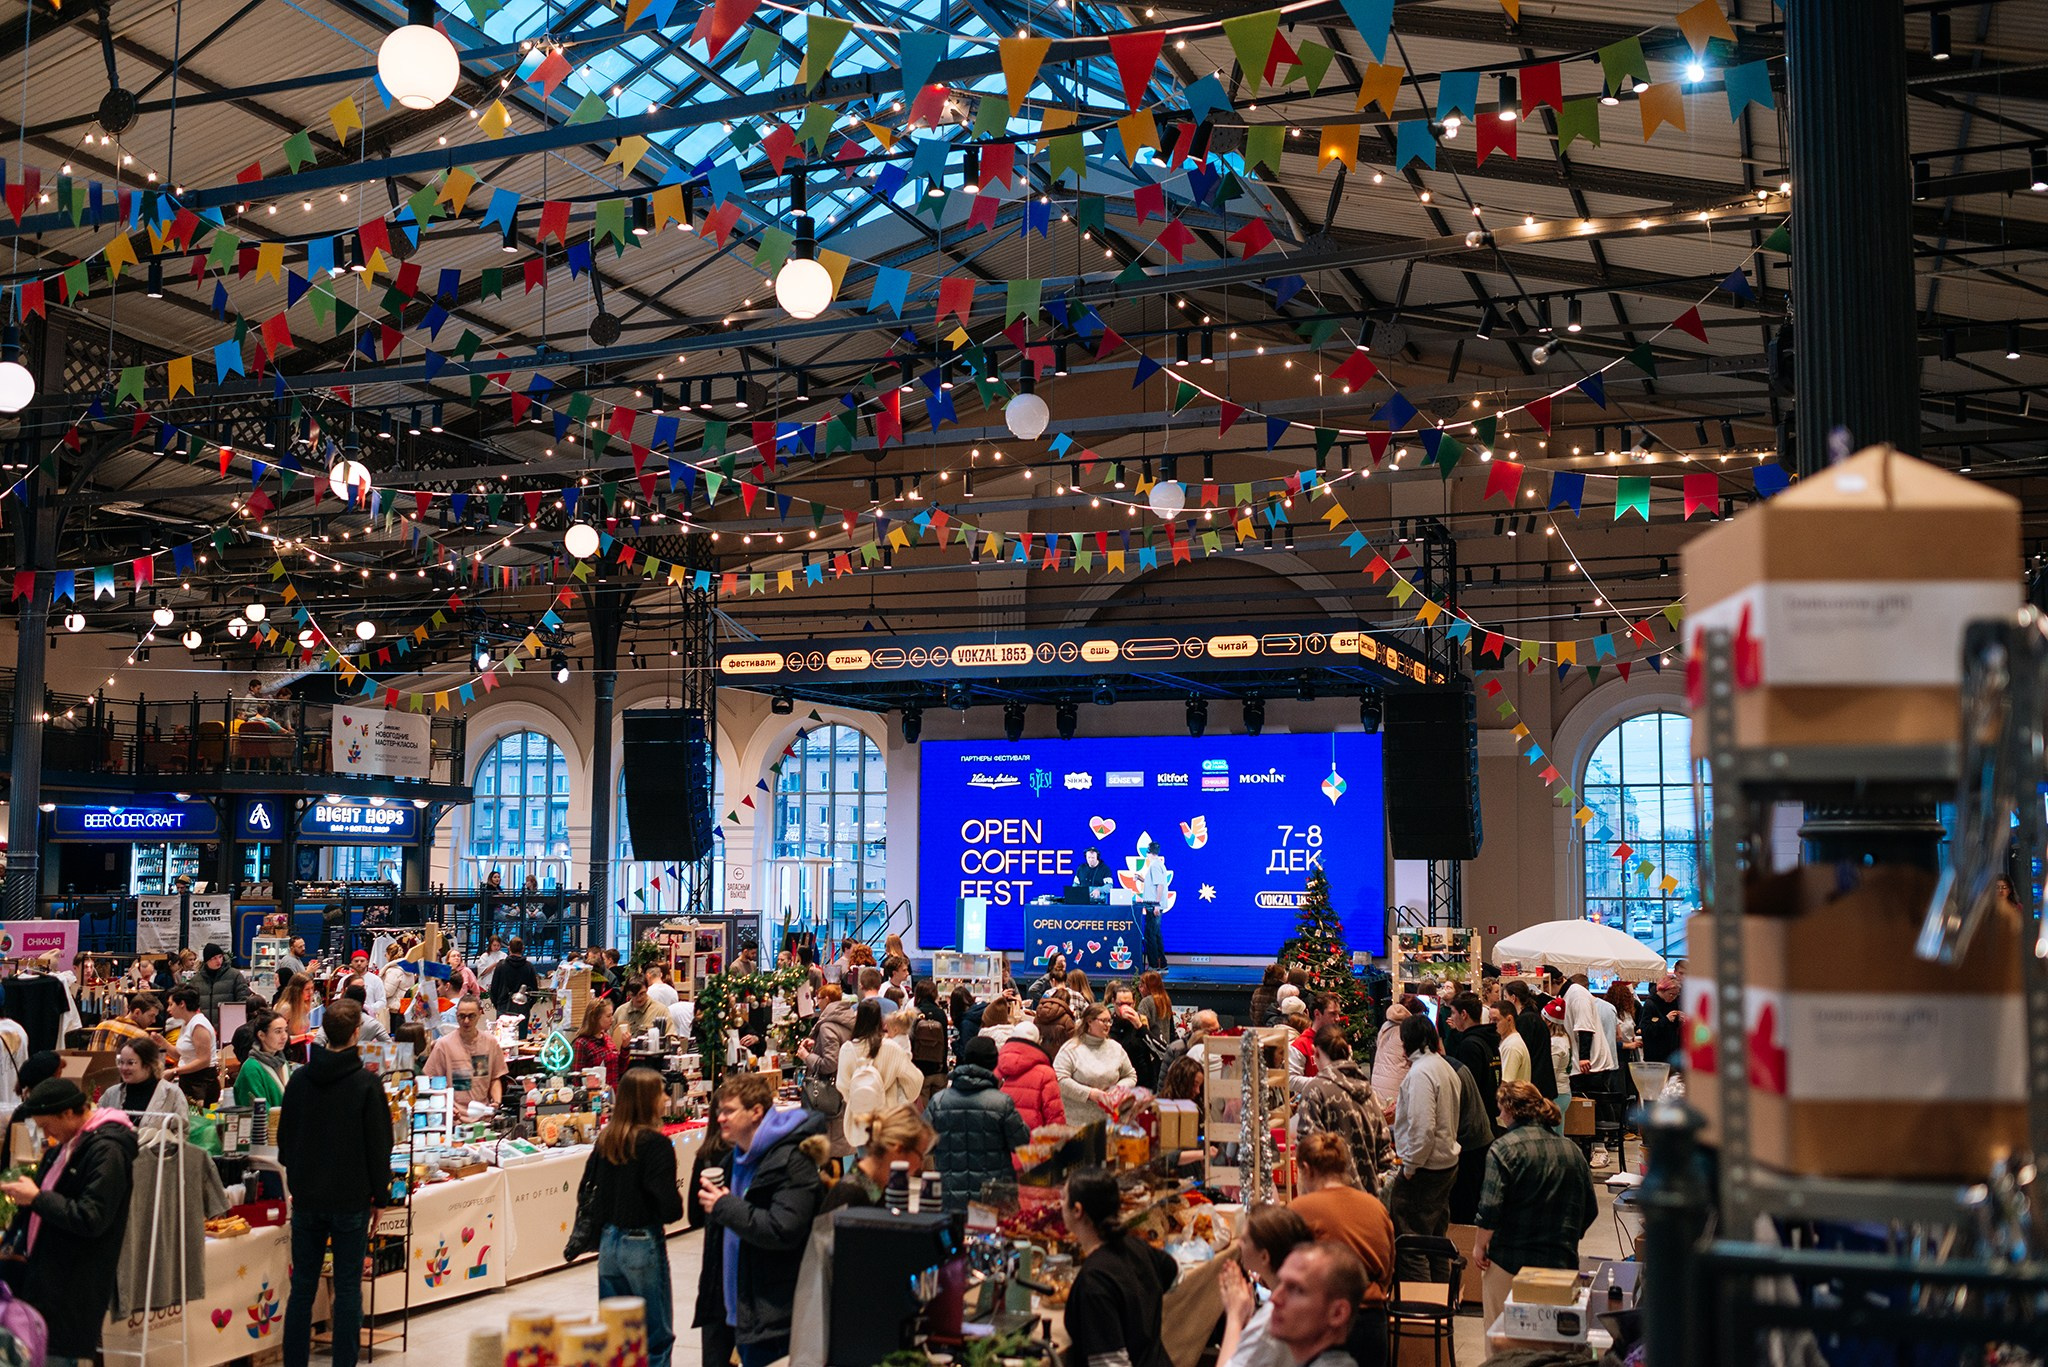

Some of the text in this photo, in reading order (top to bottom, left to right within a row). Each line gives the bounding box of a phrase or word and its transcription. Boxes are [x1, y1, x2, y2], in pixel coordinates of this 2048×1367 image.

[1090, 647, 1110, 655] ешь
[1217, 640, 1248, 651] читай
[834, 655, 863, 666] отдых
[957, 646, 1027, 663] VOKZAL 1853
[728, 658, 776, 669] фестивали
[375, 731, 409, 740] НОВОГОДНИЕ
[375, 739, 418, 749] МАСТЕР-КЛАССЫ
[1157, 773, 1188, 782] Kitfort
[1239, 769, 1285, 783] MONIN
[84, 814, 112, 827] BEER
[145, 813, 185, 827] CRAFT
[365, 808, 404, 825] HOPS
[961, 819, 1042, 844] OPEN
[961, 849, 1074, 875] COFFEE
[1266, 849, 1323, 875] ДЕК
[960, 880, 1033, 906] FEST
[1260, 894, 1294, 906] VOKZAL
[1033, 919, 1133, 931] OPEN COFFEE FEST
[27, 937, 61, 946] CHIKALAB
[515, 1187, 558, 1203] ART OF TEA
